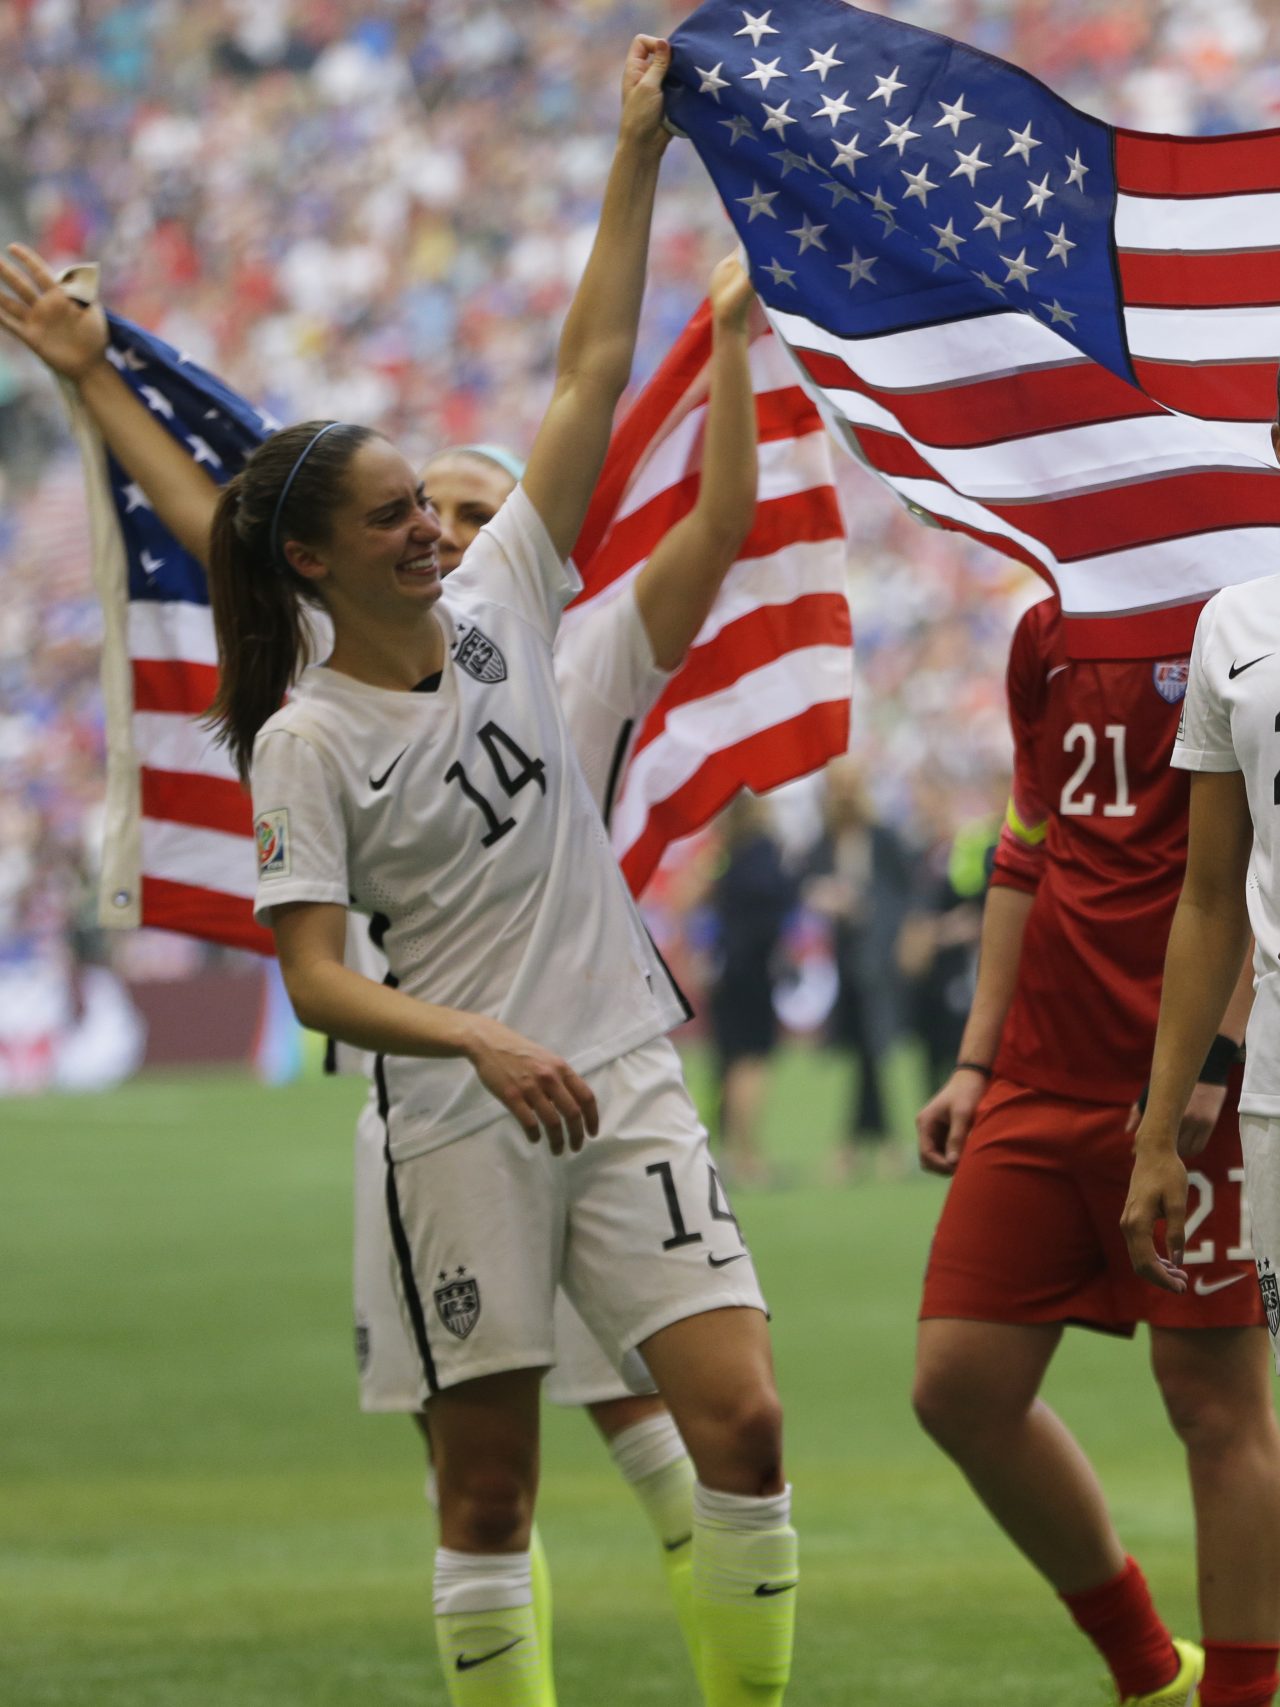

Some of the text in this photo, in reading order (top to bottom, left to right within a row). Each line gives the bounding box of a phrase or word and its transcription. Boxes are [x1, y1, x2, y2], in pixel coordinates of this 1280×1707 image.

[444, 720, 547, 848] 14
[1060, 722, 1137, 818] 21
[645, 1161, 746, 1252] 14
[1183, 1168, 1256, 1265] 21
